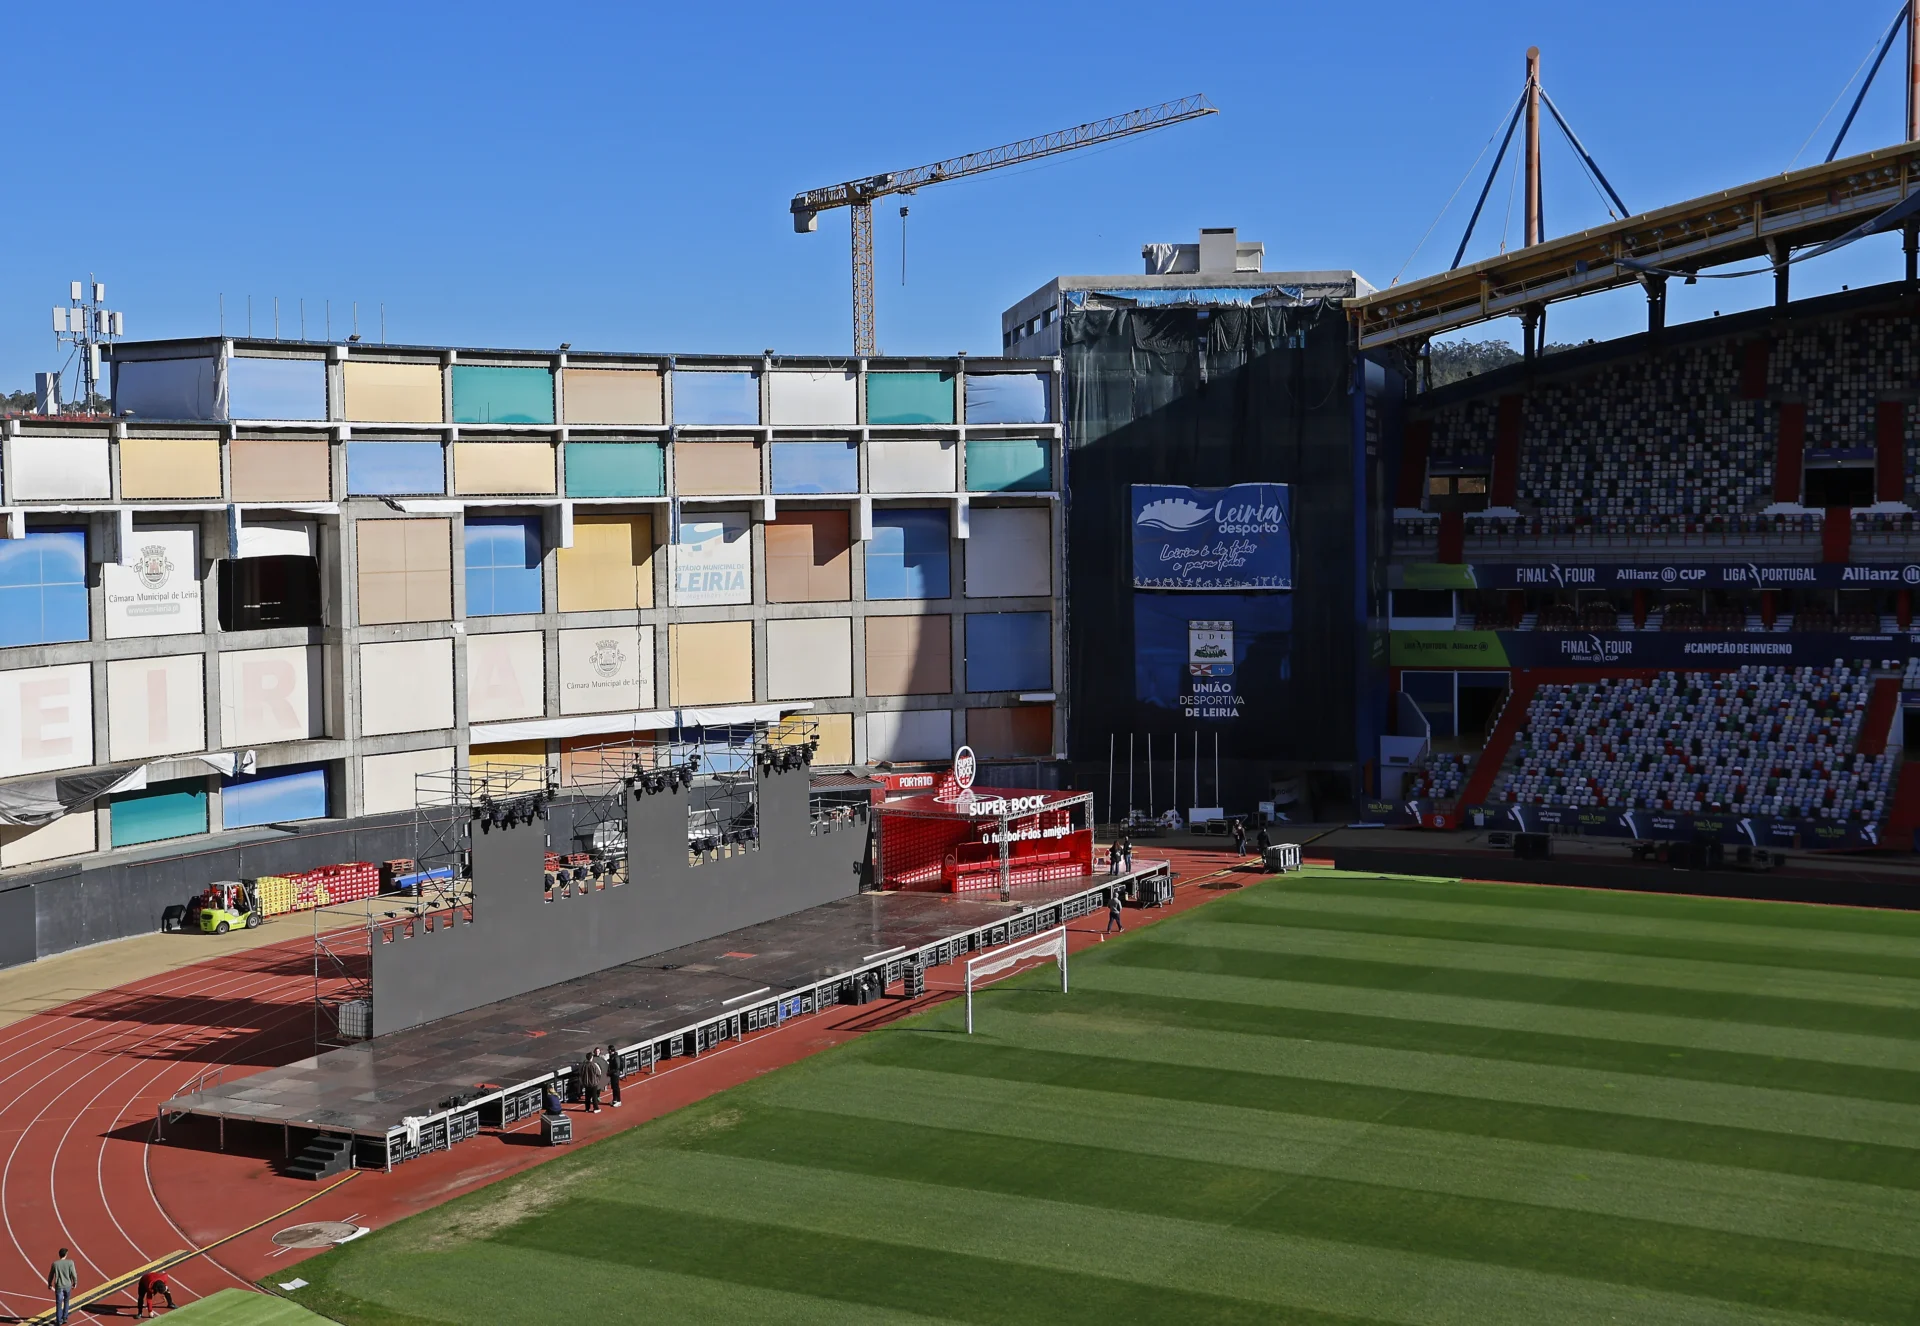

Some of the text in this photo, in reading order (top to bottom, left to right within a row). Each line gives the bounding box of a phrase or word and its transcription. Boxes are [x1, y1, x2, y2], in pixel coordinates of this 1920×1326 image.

[1214, 499, 1283, 523] Leiria
[1218, 521, 1279, 536] desporto
[1160, 544, 1199, 561] Leiria
[702, 563, 736, 571] MUNICIPAL
[1182, 559, 1218, 577] para
[1516, 568, 1595, 583] FINAL FOUR
[1616, 568, 1707, 580] Allianz CUP
[1723, 568, 1816, 581] LIGA PORTUGAL
[1842, 567, 1899, 581] Allianz
[676, 571, 745, 593] LEIRIA
[108, 590, 198, 603] Câmara Municipal de Leiria
[1452, 642, 1478, 650] Allianz
[1561, 640, 1632, 654] FINAL FOUR
[1684, 643, 1792, 654] #CAMPEÃO DE INVERNO
[566, 681, 590, 690] Câmara
[591, 679, 622, 689] Municipal
[1192, 681, 1232, 693] UNIÃO
[1179, 696, 1245, 705] DESPORTIVA
[1185, 708, 1239, 717] DE LEIRIA
[957, 756, 973, 769] SUPER
[957, 766, 973, 778] BOCK
[969, 795, 1045, 816] SUPER BOCK
[982, 833, 989, 844] O
[1027, 828, 1041, 840] dos
[1042, 825, 1070, 839] amigos
